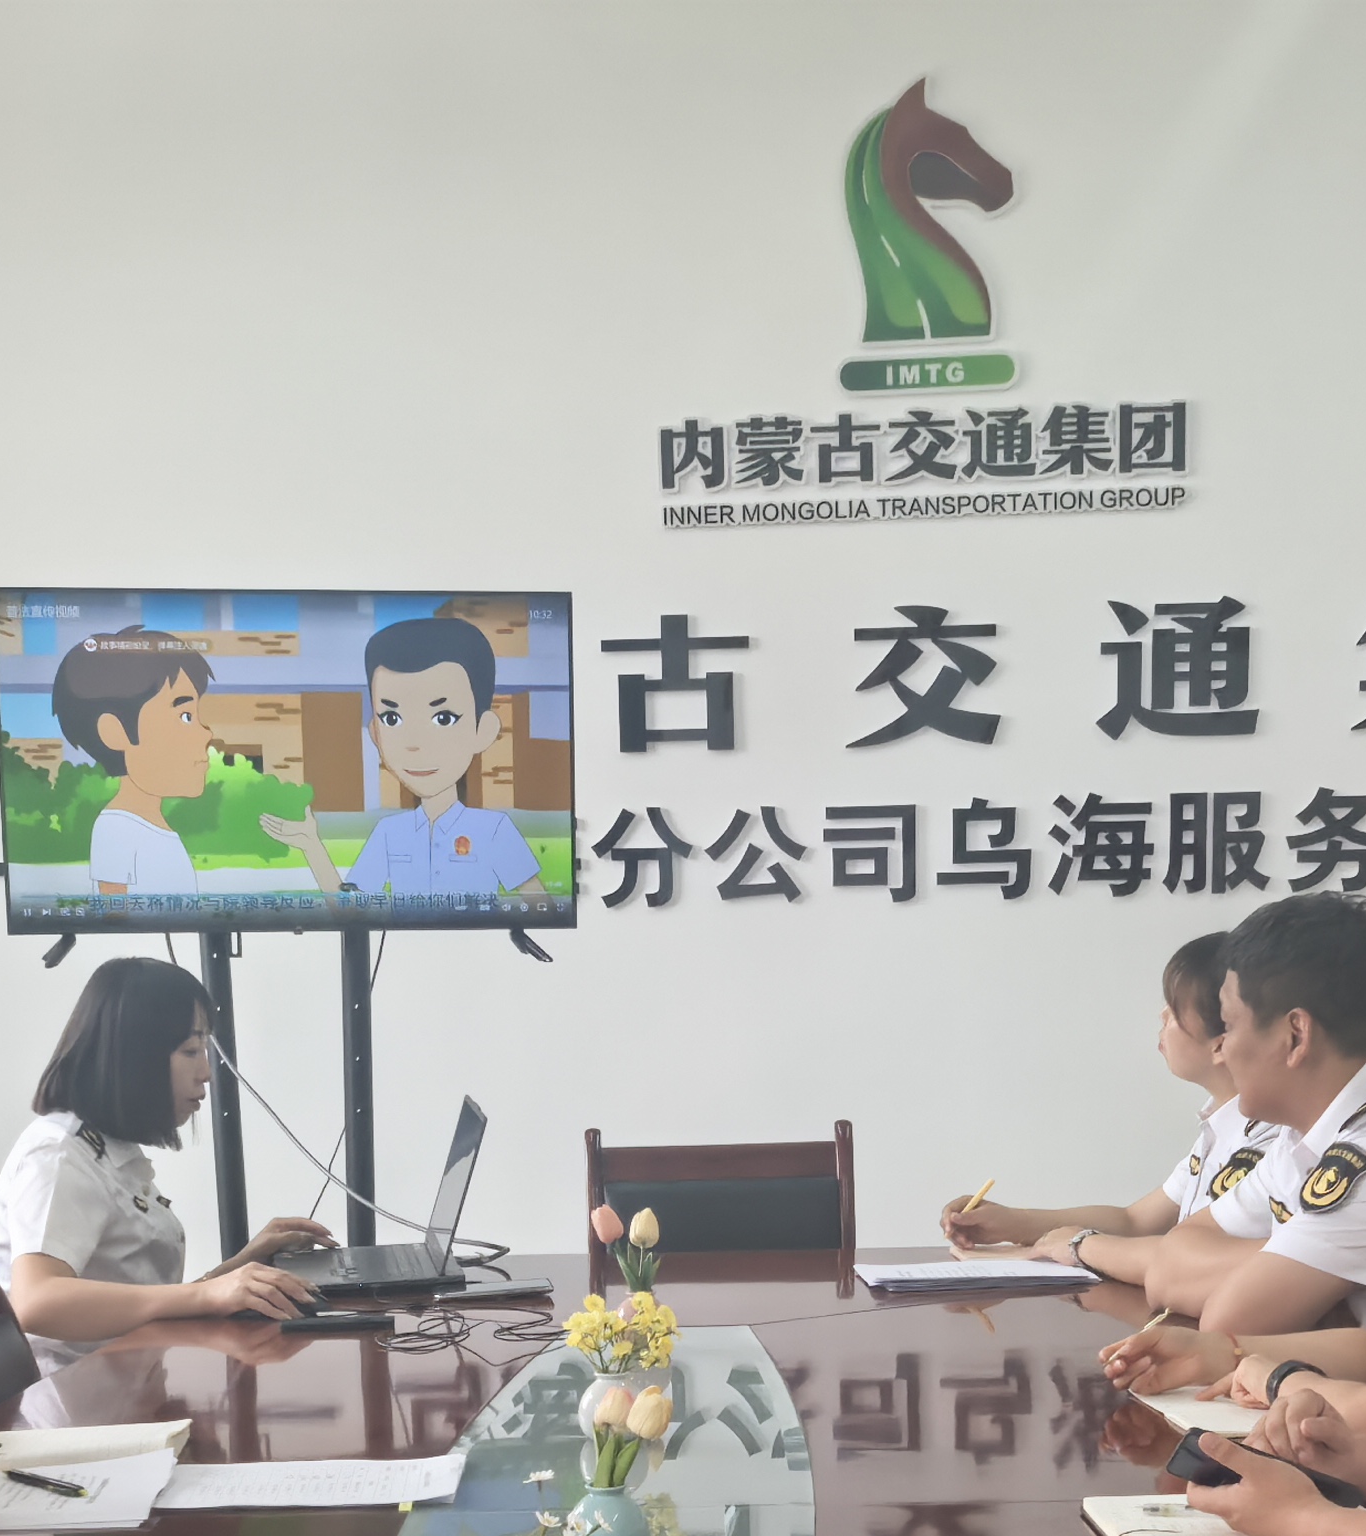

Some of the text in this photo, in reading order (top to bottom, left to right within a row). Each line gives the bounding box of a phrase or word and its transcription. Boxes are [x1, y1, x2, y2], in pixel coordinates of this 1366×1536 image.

[886, 361, 966, 387] IMTG
[660, 401, 1187, 490] 内蒙古交通集团
[663, 487, 1186, 527] INNER MONGOLIA TRANSPORTATION GROUP
